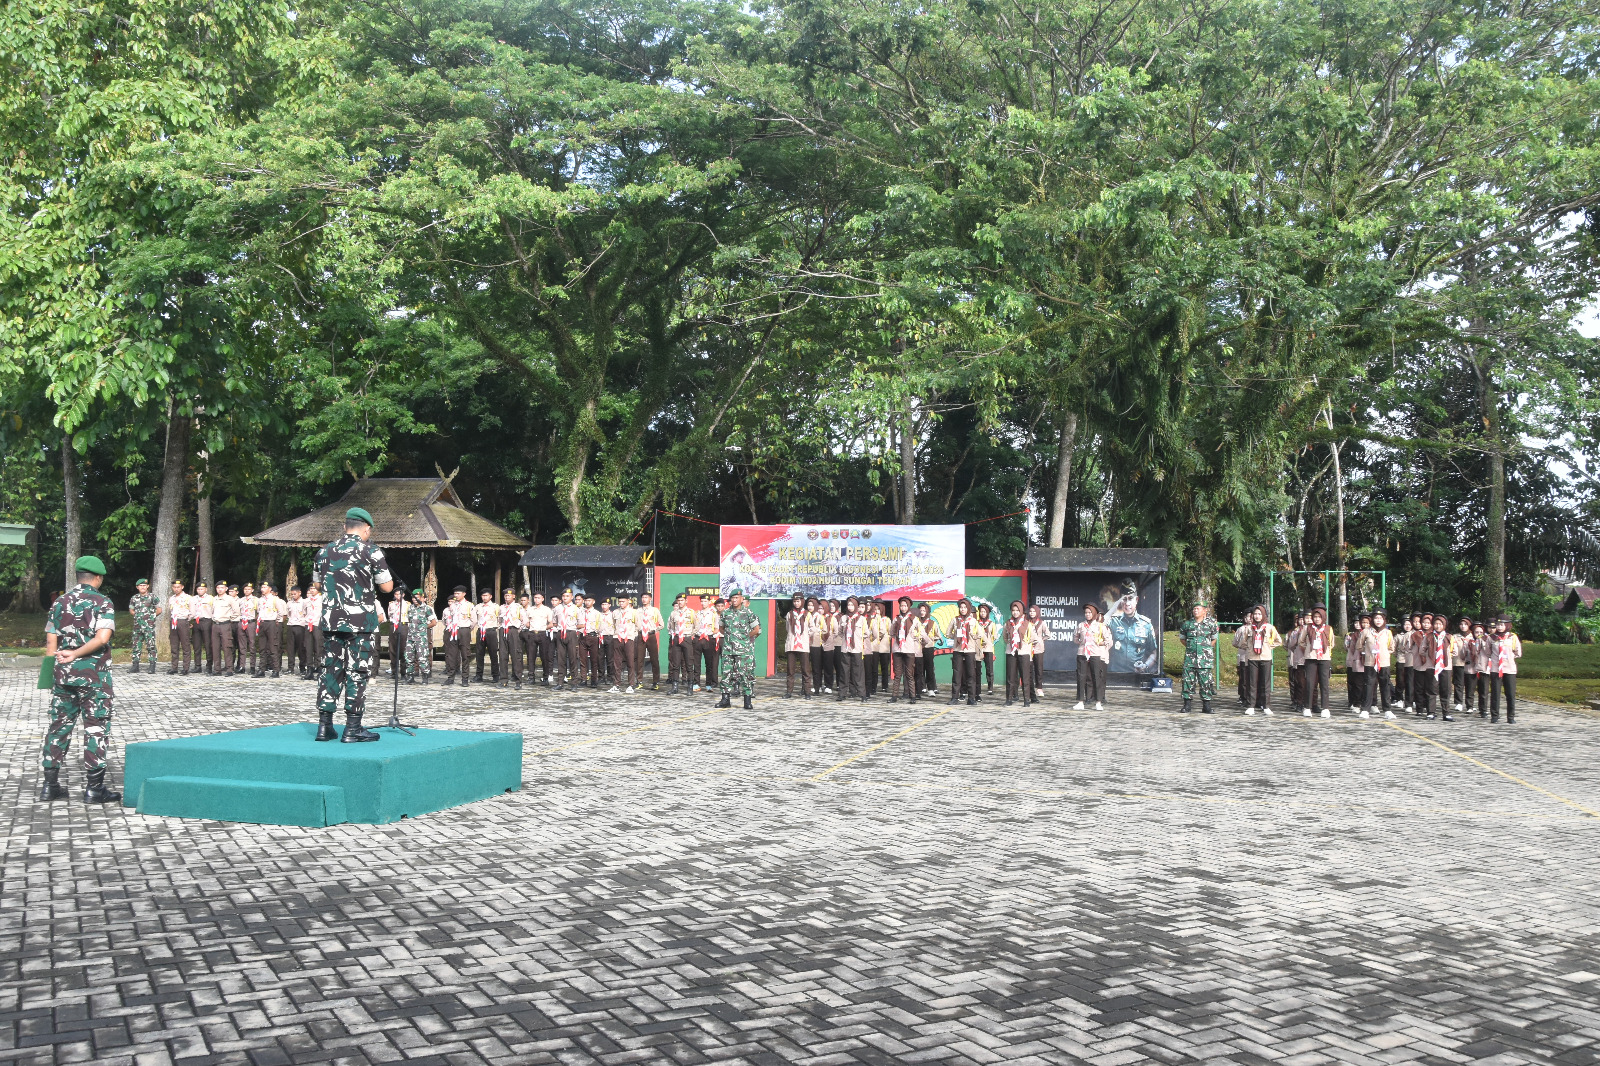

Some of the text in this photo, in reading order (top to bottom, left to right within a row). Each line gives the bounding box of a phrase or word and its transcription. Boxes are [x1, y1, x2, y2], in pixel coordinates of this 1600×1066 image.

[778, 546, 903, 561] KEGIATAN PERSAMI
[768, 565, 796, 574] KADET
[797, 565, 838, 574] REPUBLIK
[769, 575, 796, 585] KODIM
[843, 576, 876, 586] SUNGAI
[877, 576, 913, 586] TENGAH
[1036, 596, 1078, 605] BEKERJALAH
[1040, 608, 1064, 617] ENGAN
[1053, 620, 1077, 629] IBADAH
[1058, 632, 1073, 641] DAN
